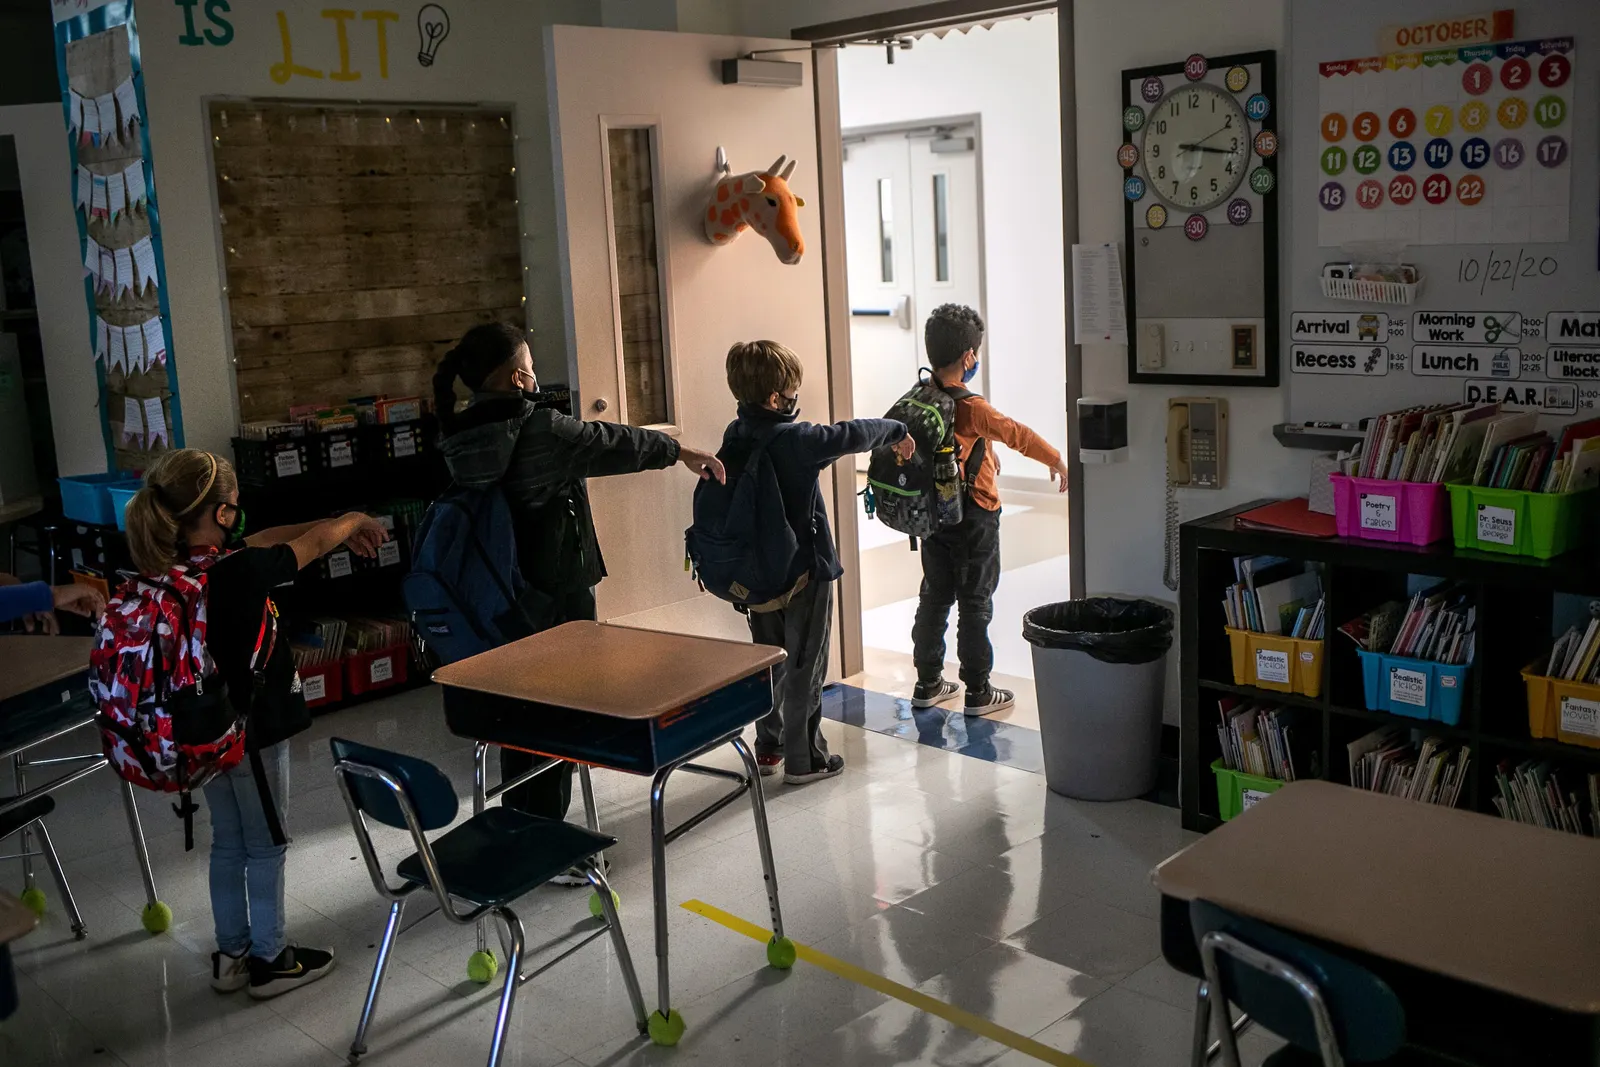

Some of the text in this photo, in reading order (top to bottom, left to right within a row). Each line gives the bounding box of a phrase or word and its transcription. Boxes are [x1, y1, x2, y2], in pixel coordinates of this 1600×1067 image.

[175, 0, 234, 47] IS
[1396, 18, 1489, 46] OCTOBER
[270, 9, 399, 85] LIT
[1326, 63, 1347, 72] Sunday
[1358, 60, 1382, 69] Monday
[1463, 48, 1493, 58] Thursday
[1505, 45, 1526, 53] Friday
[1540, 40, 1570, 49] Saturday
[1472, 62, 1561, 89] 1 2 3
[1188, 93, 1199, 109] 12
[1211, 98, 1216, 113] 1
[1249, 100, 1265, 114] :10
[1170, 102, 1180, 117] 11
[1225, 114, 1232, 129] 2
[1328, 101, 1561, 136] 4 5 6 7 8 9 10
[1156, 120, 1167, 135] 10
[1152, 144, 1160, 158] 9
[1230, 137, 1238, 151] 3
[1258, 136, 1274, 151] :15
[1327, 142, 1562, 169] 11 12 13 14 15 16 17
[1158, 165, 1166, 179] 8
[1224, 161, 1233, 176] 4
[1172, 180, 1179, 196] 7
[1210, 178, 1218, 192] 5
[1324, 180, 1482, 205] 18 19 20 21 22
[1190, 186, 1198, 200] 6
[1458, 248, 1558, 296] 10/22/20
[1295, 319, 1350, 334] Arrival
[1418, 313, 1476, 328] Morning
[1428, 329, 1465, 341] Work
[1522, 328, 1540, 337] 9:20
[1295, 350, 1357, 368] Recess
[1421, 352, 1479, 371] Lunch
[1563, 365, 1600, 378] Block
[1366, 501, 1390, 511] Poetry
[1492, 517, 1512, 526] Seuss
[1259, 654, 1285, 663] Realistic
[1393, 672, 1423, 685] Realistic
[1565, 703, 1597, 715] Fantasy
